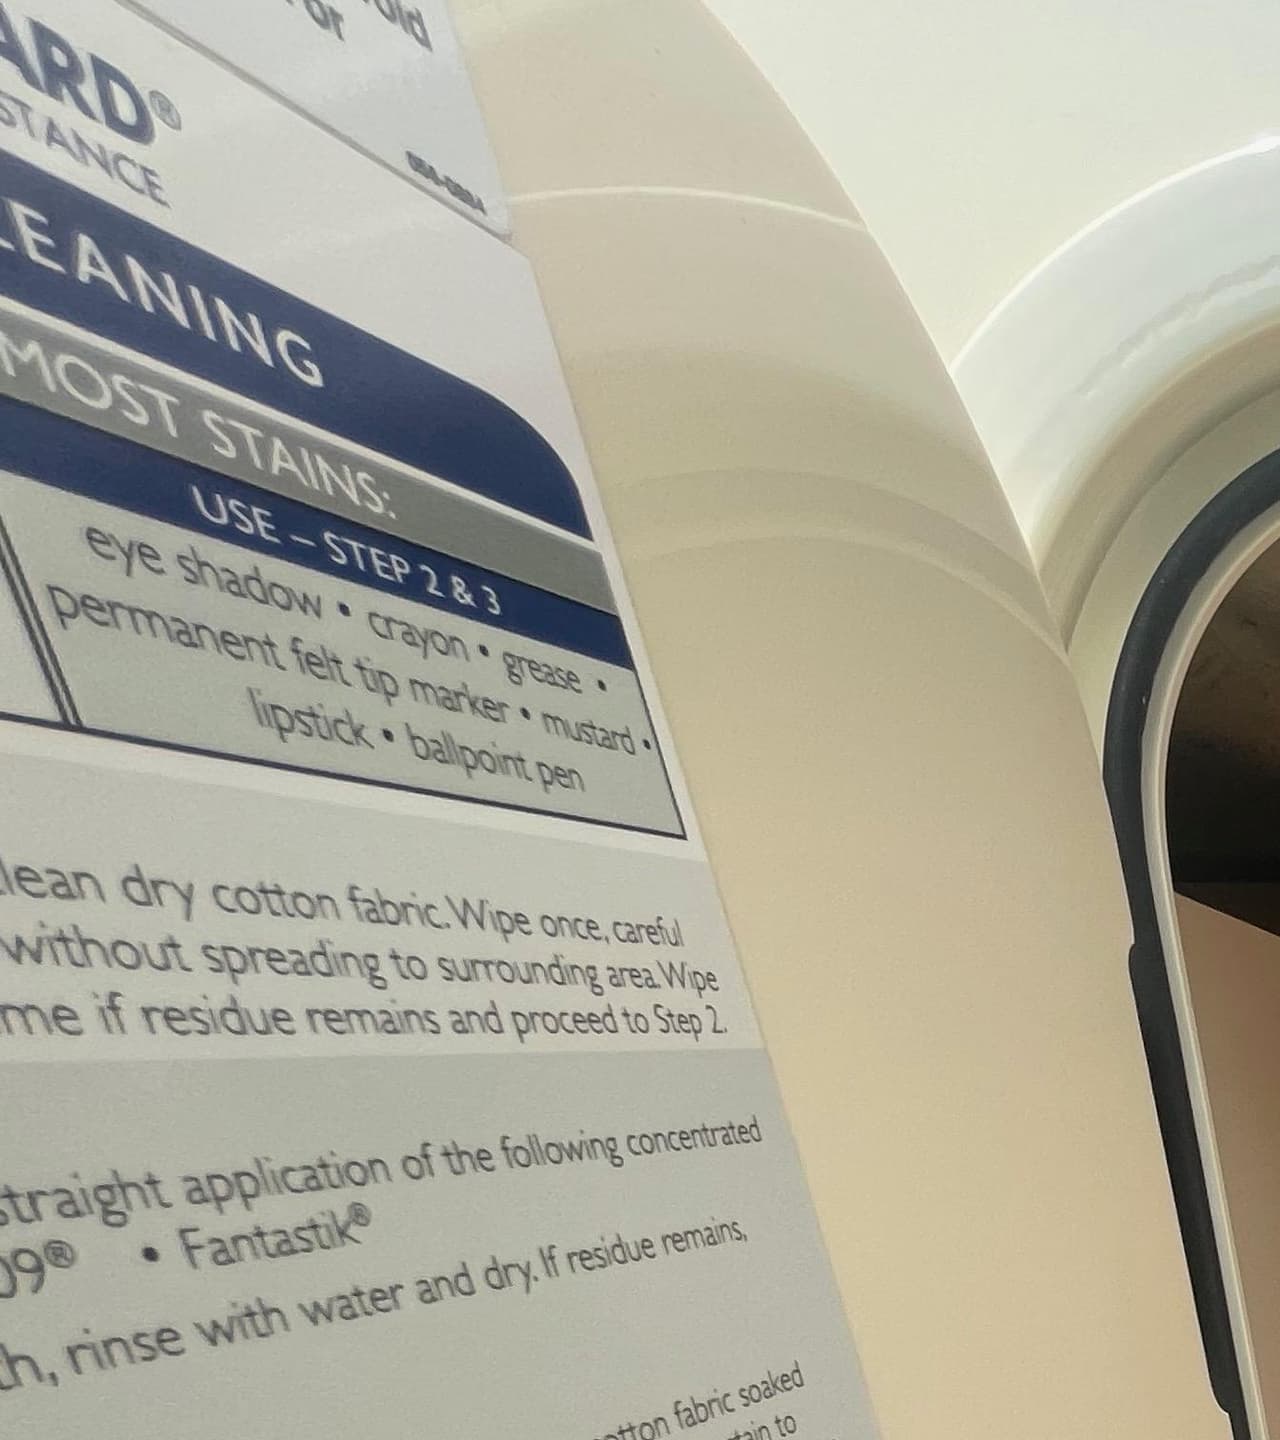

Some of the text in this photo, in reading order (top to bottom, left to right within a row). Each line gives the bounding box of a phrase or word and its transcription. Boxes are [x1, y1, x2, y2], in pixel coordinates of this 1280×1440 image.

[0, 330, 396, 519] MOST STAINS:
[192, 484, 281, 545] USE
[323, 530, 410, 583] STEP
[419, 565, 445, 598] 2
[451, 576, 477, 608] &
[483, 586, 503, 615] 3
[85, 526, 583, 694] eye shadow crayon grease
[46, 583, 637, 756] permanent felt tip marker mustard
[247, 686, 586, 794] lipstick ballpoint pen
[120, 863, 194, 922] dry
[211, 880, 342, 921] cotton
[348, 884, 451, 930] fabric.
[445, 895, 533, 944] Wipe
[541, 912, 611, 945] once,
[612, 916, 685, 948] careful
[0, 919, 720, 998] without spreading to surrounding area. Wipe
[93, 991, 128, 1035] if
[141, 994, 297, 1036] residue
[305, 999, 441, 1036] remains
[450, 1000, 505, 1035] and
[511, 1004, 618, 1044] proceed
[621, 1006, 650, 1034] to
[653, 1004, 704, 1042] Step
[705, 1004, 728, 1034] 2.
[181, 1150, 393, 1215] application
[402, 1141, 436, 1181] of
[441, 1139, 497, 1176] the
[500, 1129, 625, 1168] following
[627, 1115, 763, 1157] concentrated
[66, 1328, 186, 1376] rinse
[193, 1298, 291, 1348] with
[298, 1282, 403, 1327] water
[415, 1262, 476, 1306] and
[484, 1255, 538, 1295] dry.
[539, 1245, 561, 1279] If
[566, 1233, 657, 1274] residue
[661, 1216, 748, 1256] remains,
[673, 1388, 736, 1431] fabric
[738, 1360, 805, 1409] soaked
[774, 1414, 798, 1438] to
